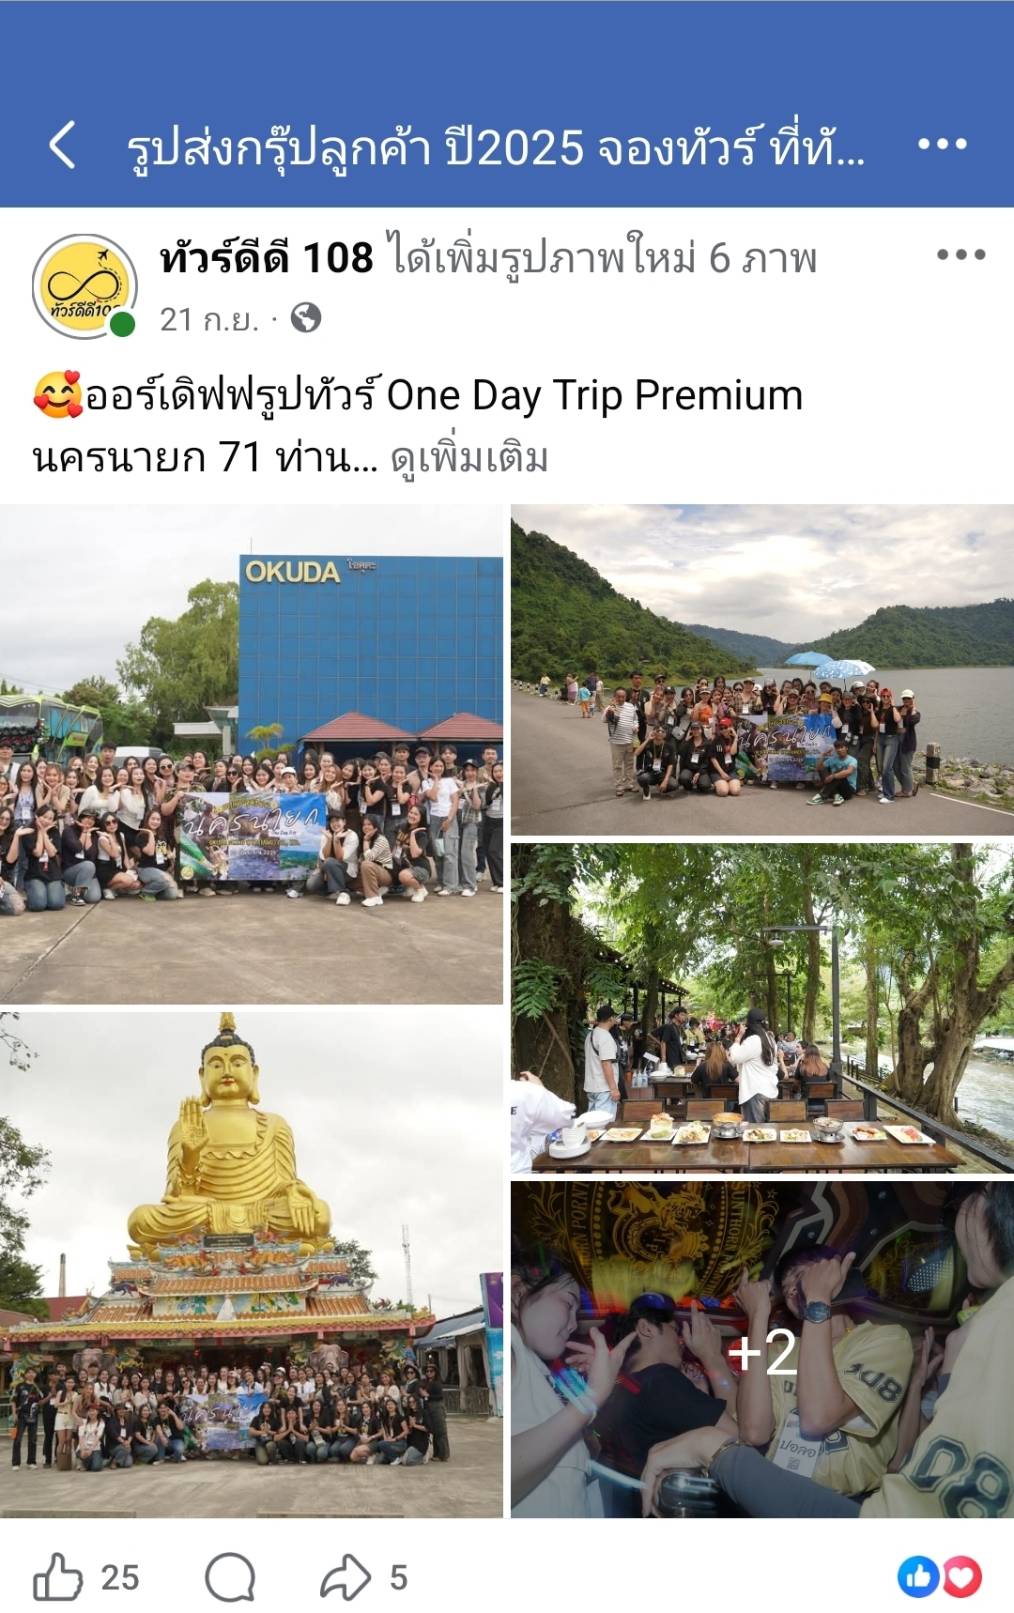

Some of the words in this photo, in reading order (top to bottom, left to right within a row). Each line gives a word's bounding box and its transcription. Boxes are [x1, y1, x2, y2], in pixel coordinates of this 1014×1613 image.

[127, 123, 431, 178] รูปส่งกรุ๊ปลูกค้า
[444, 123, 584, 166] ปี2025
[599, 122, 766, 166] จองทัวร์
[159, 235, 289, 274] ทัวร์ดีดี
[303, 240, 374, 274] 108
[385, 227, 695, 285] ได้เพิ่มรูปภาพใหม่
[709, 241, 731, 274] 6
[741, 247, 817, 274] ภาพ
[50, 300, 122, 317] ทัวร์ดีดี10
[160, 306, 190, 332] 21
[203, 311, 259, 332] ก.ย.
[86, 372, 383, 422] ออร์เดิฟฟรูปทัวร์
[387, 378, 461, 411] One
[473, 378, 543, 420] Day
[552, 377, 623, 419] Trip
[636, 377, 803, 411] Premium
[32, 446, 205, 473] นครนายก
[218, 440, 258, 473] 71
[275, 437, 378, 473] ท่าน...
[391, 426, 548, 484] ดูเพิ่มเติม
[245, 560, 341, 583] OKUDA
[184, 808, 319, 836] นครนายก
[100, 1563, 140, 1591] 25
[389, 1563, 408, 1591] 5
